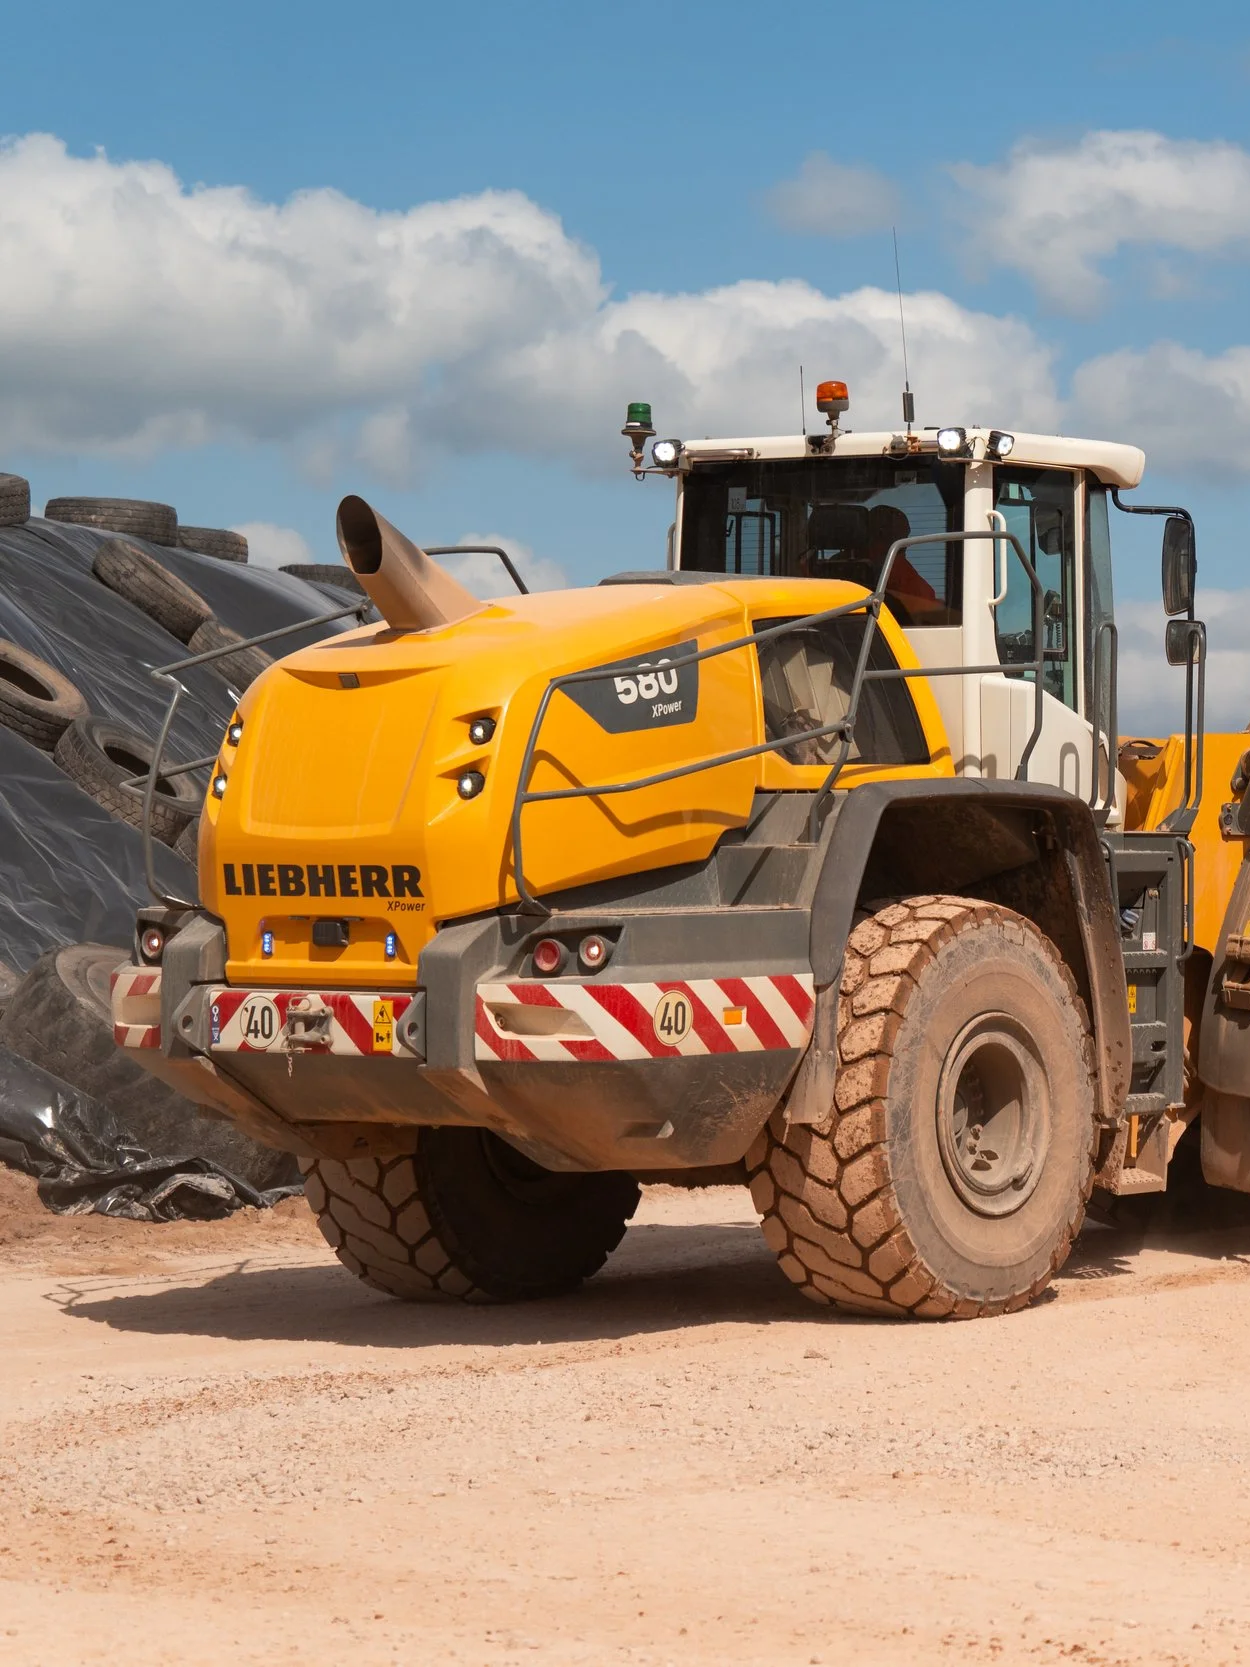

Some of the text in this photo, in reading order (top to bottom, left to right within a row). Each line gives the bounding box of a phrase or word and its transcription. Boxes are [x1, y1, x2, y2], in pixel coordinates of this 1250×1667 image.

[613, 658, 678, 704] 580
[652, 700, 682, 718] XPower
[223, 863, 425, 898] LIEBHERR
[387, 901, 426, 912] XPower
[246, 1005, 273, 1039] 40
[660, 1001, 686, 1035] 40
